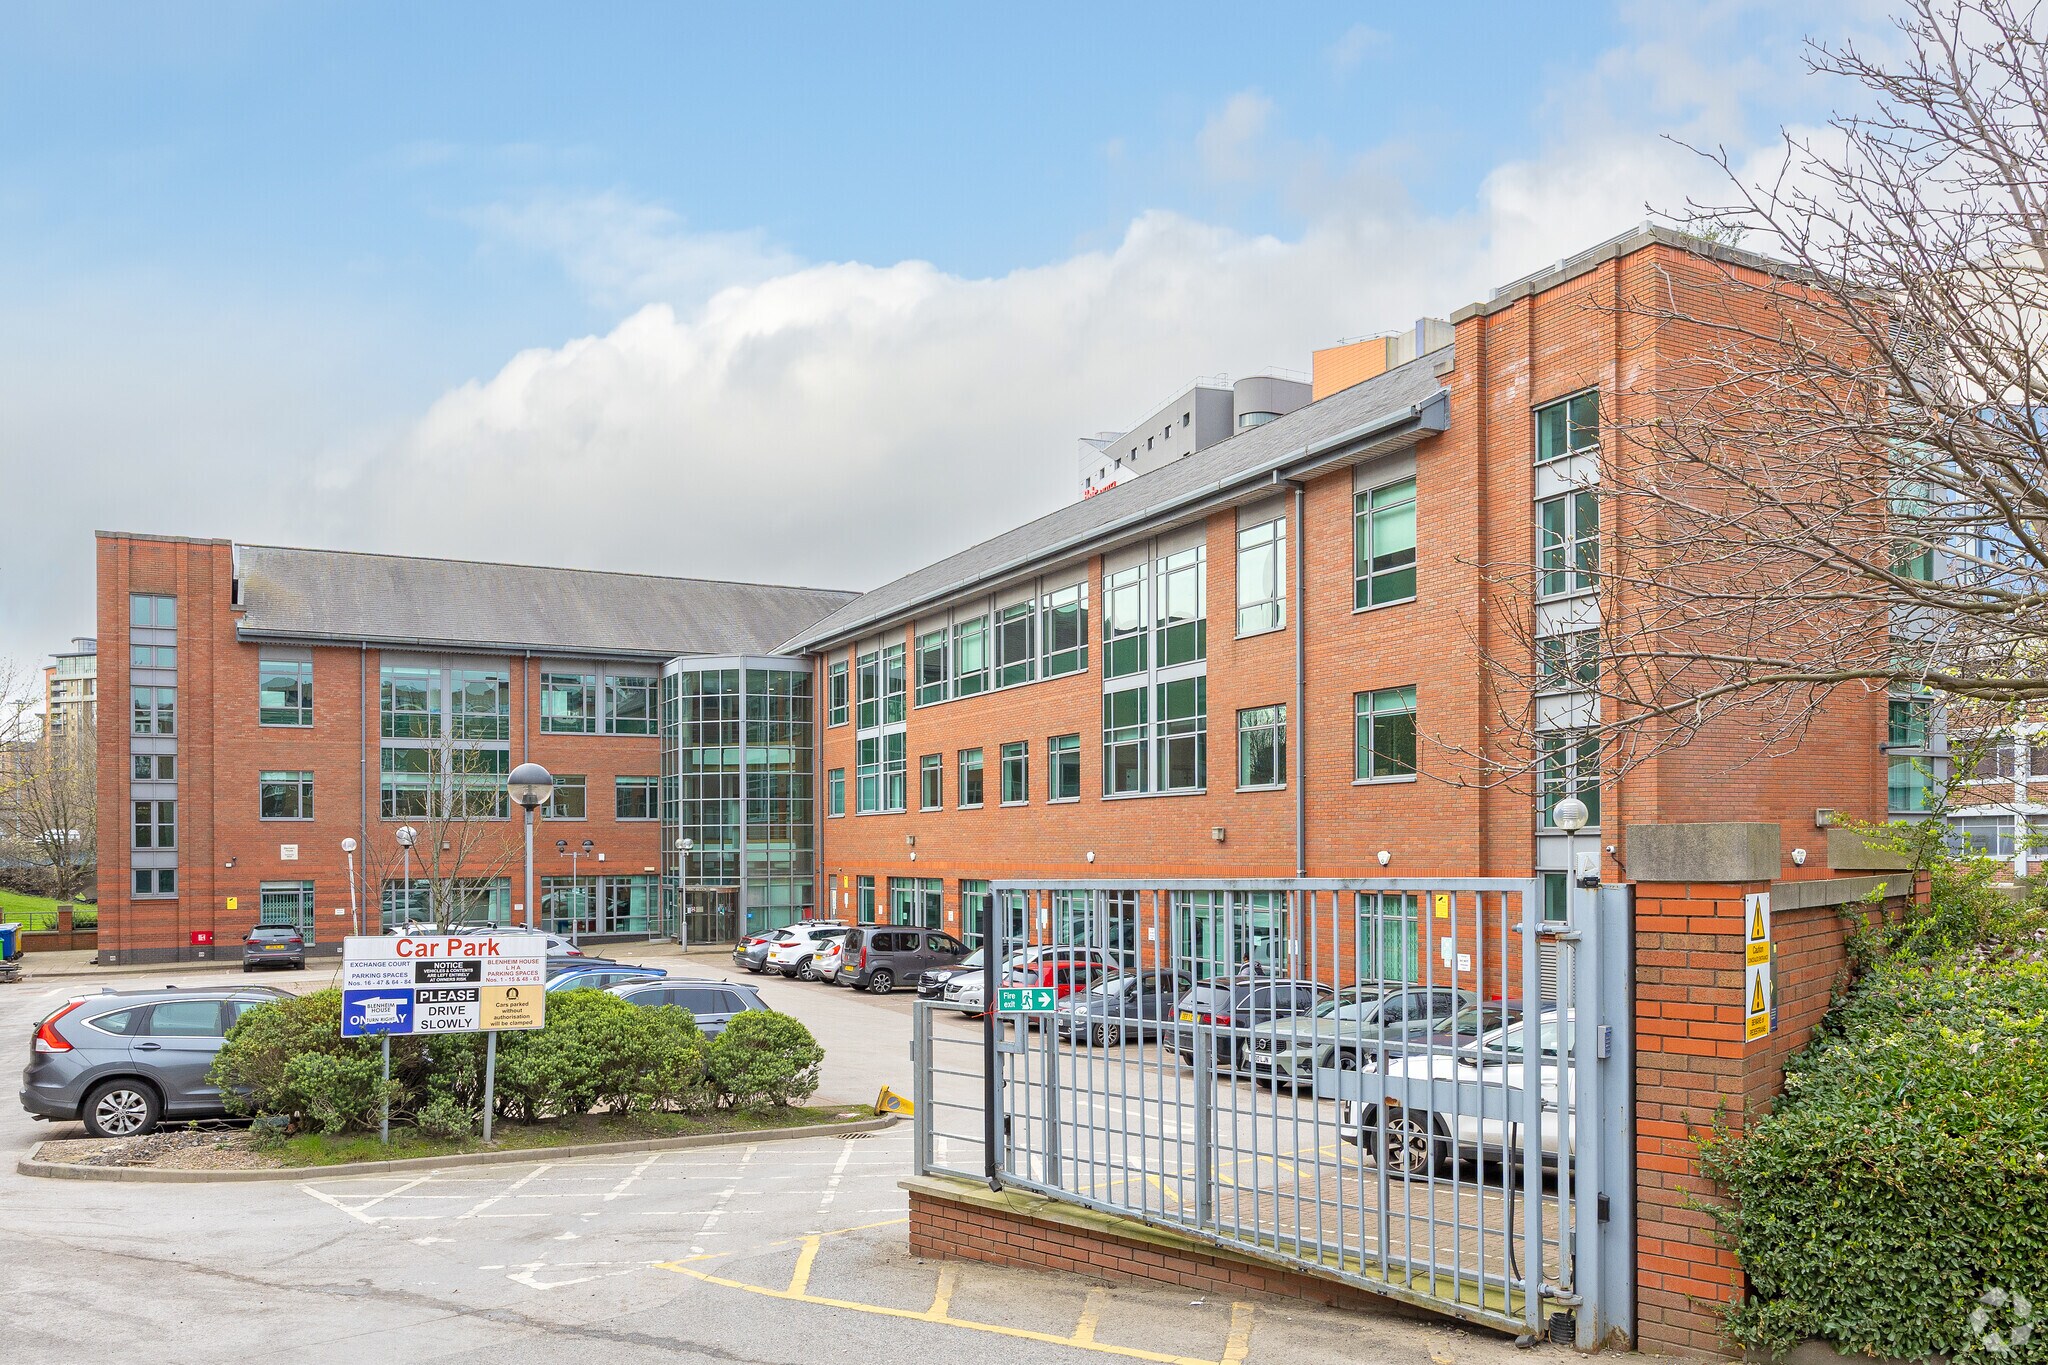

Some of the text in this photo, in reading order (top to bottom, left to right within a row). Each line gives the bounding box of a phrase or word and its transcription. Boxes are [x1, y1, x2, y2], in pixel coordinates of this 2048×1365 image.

[396, 938, 500, 957] Car Park
[420, 990, 475, 1002] PLEASE
[428, 1006, 465, 1016] DRIVE
[421, 1019, 472, 1029] SLOWLY
